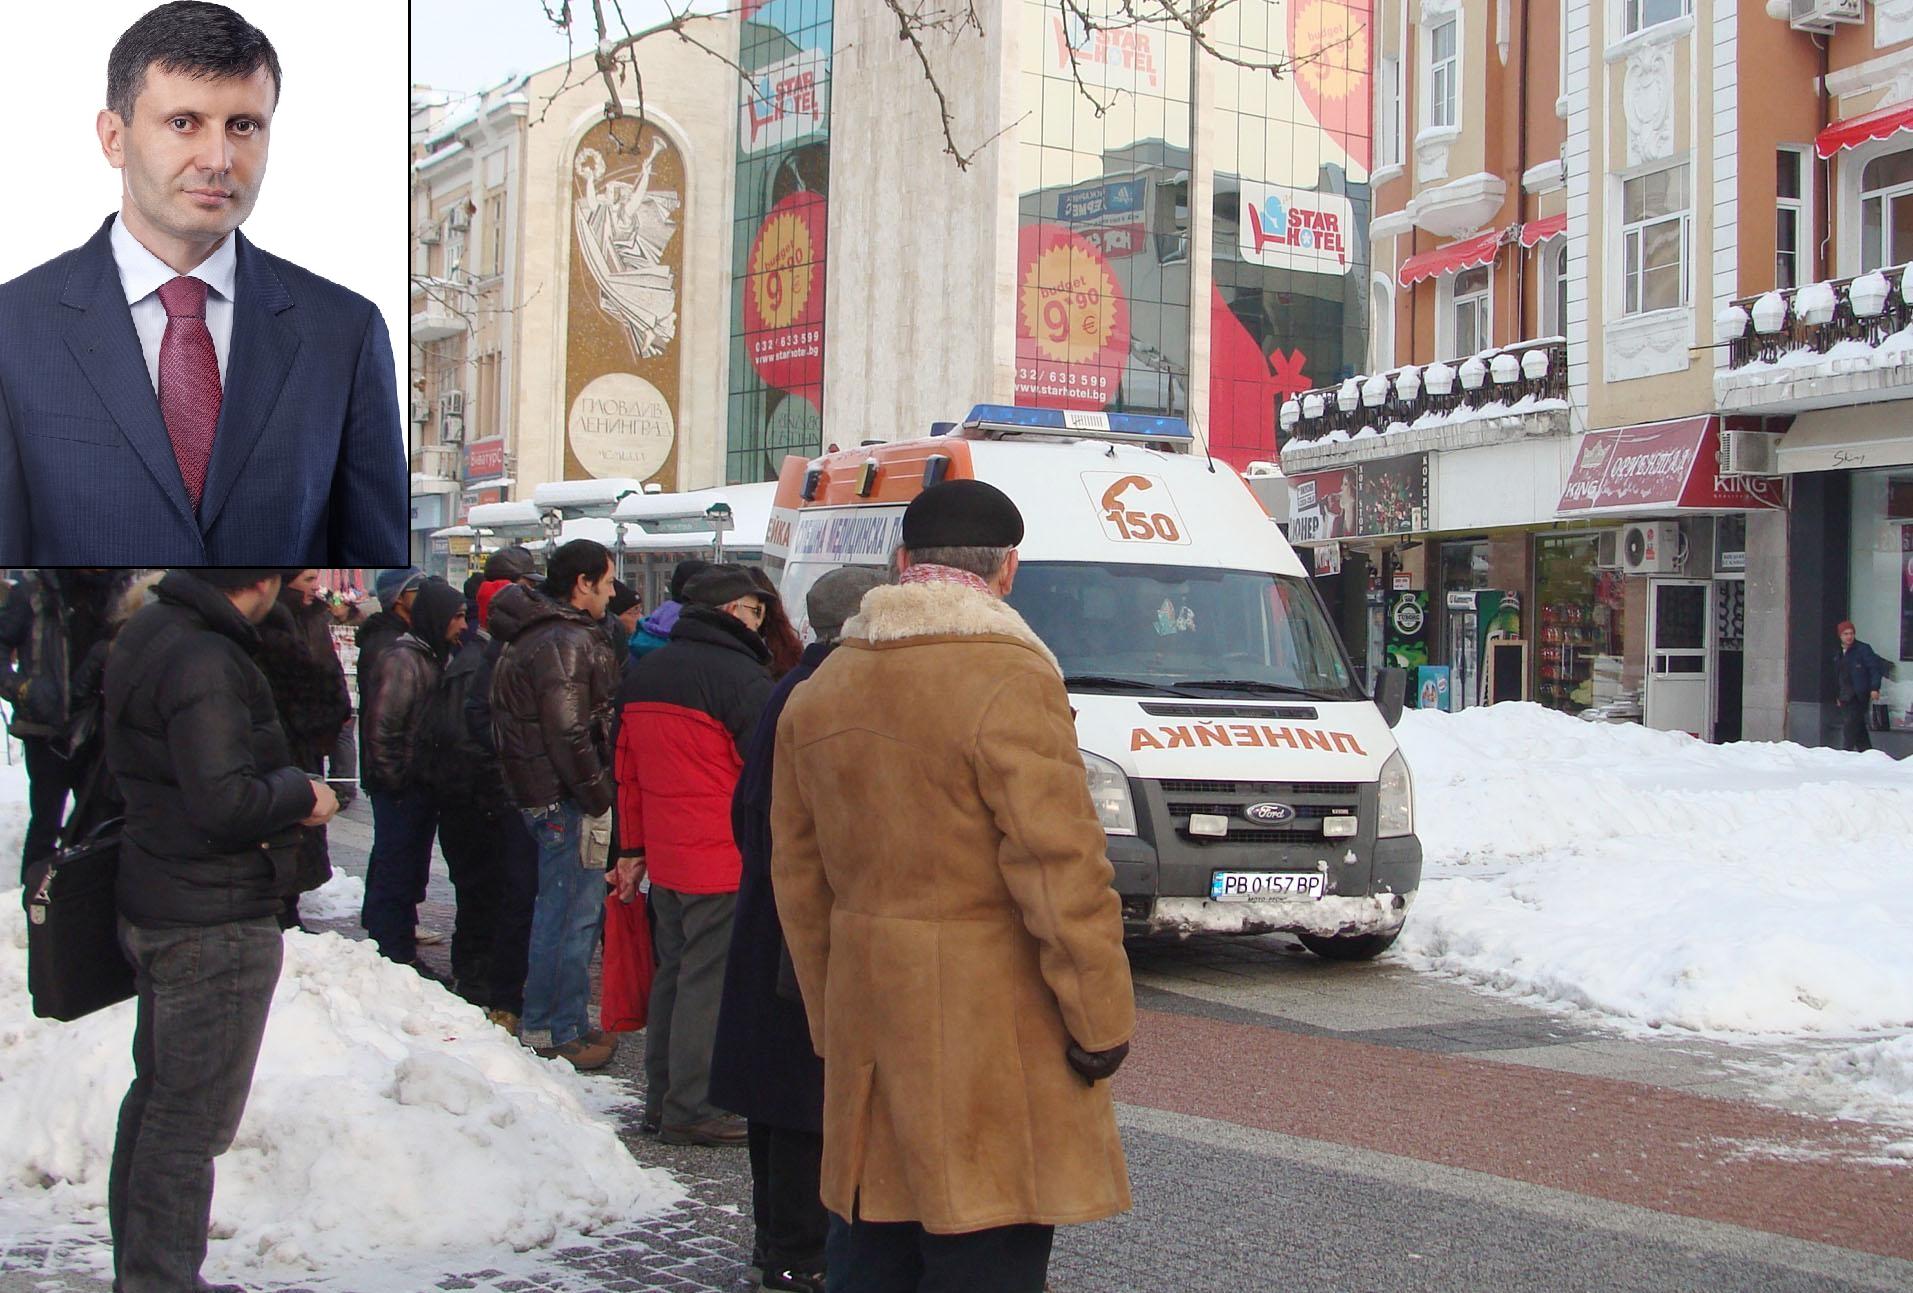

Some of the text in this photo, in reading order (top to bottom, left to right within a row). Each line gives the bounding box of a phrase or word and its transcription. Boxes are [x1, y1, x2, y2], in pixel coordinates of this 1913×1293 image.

[1095, 28, 1151, 53] STAR
[1094, 44, 1156, 74] HOTEL
[776, 71, 813, 102] STAR
[1287, 207, 1339, 232] STAR
[1286, 227, 1345, 254] HOTEL
[1041, 276, 1087, 299] budget
[801, 331, 819, 344] 599
[1050, 371, 1076, 385] 633
[1081, 375, 1107, 388] 599
[581, 398, 663, 418] ПЛОВДИВ
[576, 415, 672, 437] ЛЕНИНГРАД
[1565, 480, 1599, 499] KING
[1713, 475, 1767, 493] KING
[766, 515, 792, 548] ЕЙКА
[1106, 510, 1180, 542] 150
[1257, 805, 1286, 819] Ford
[1225, 876, 1320, 895] PB 0157 BP
